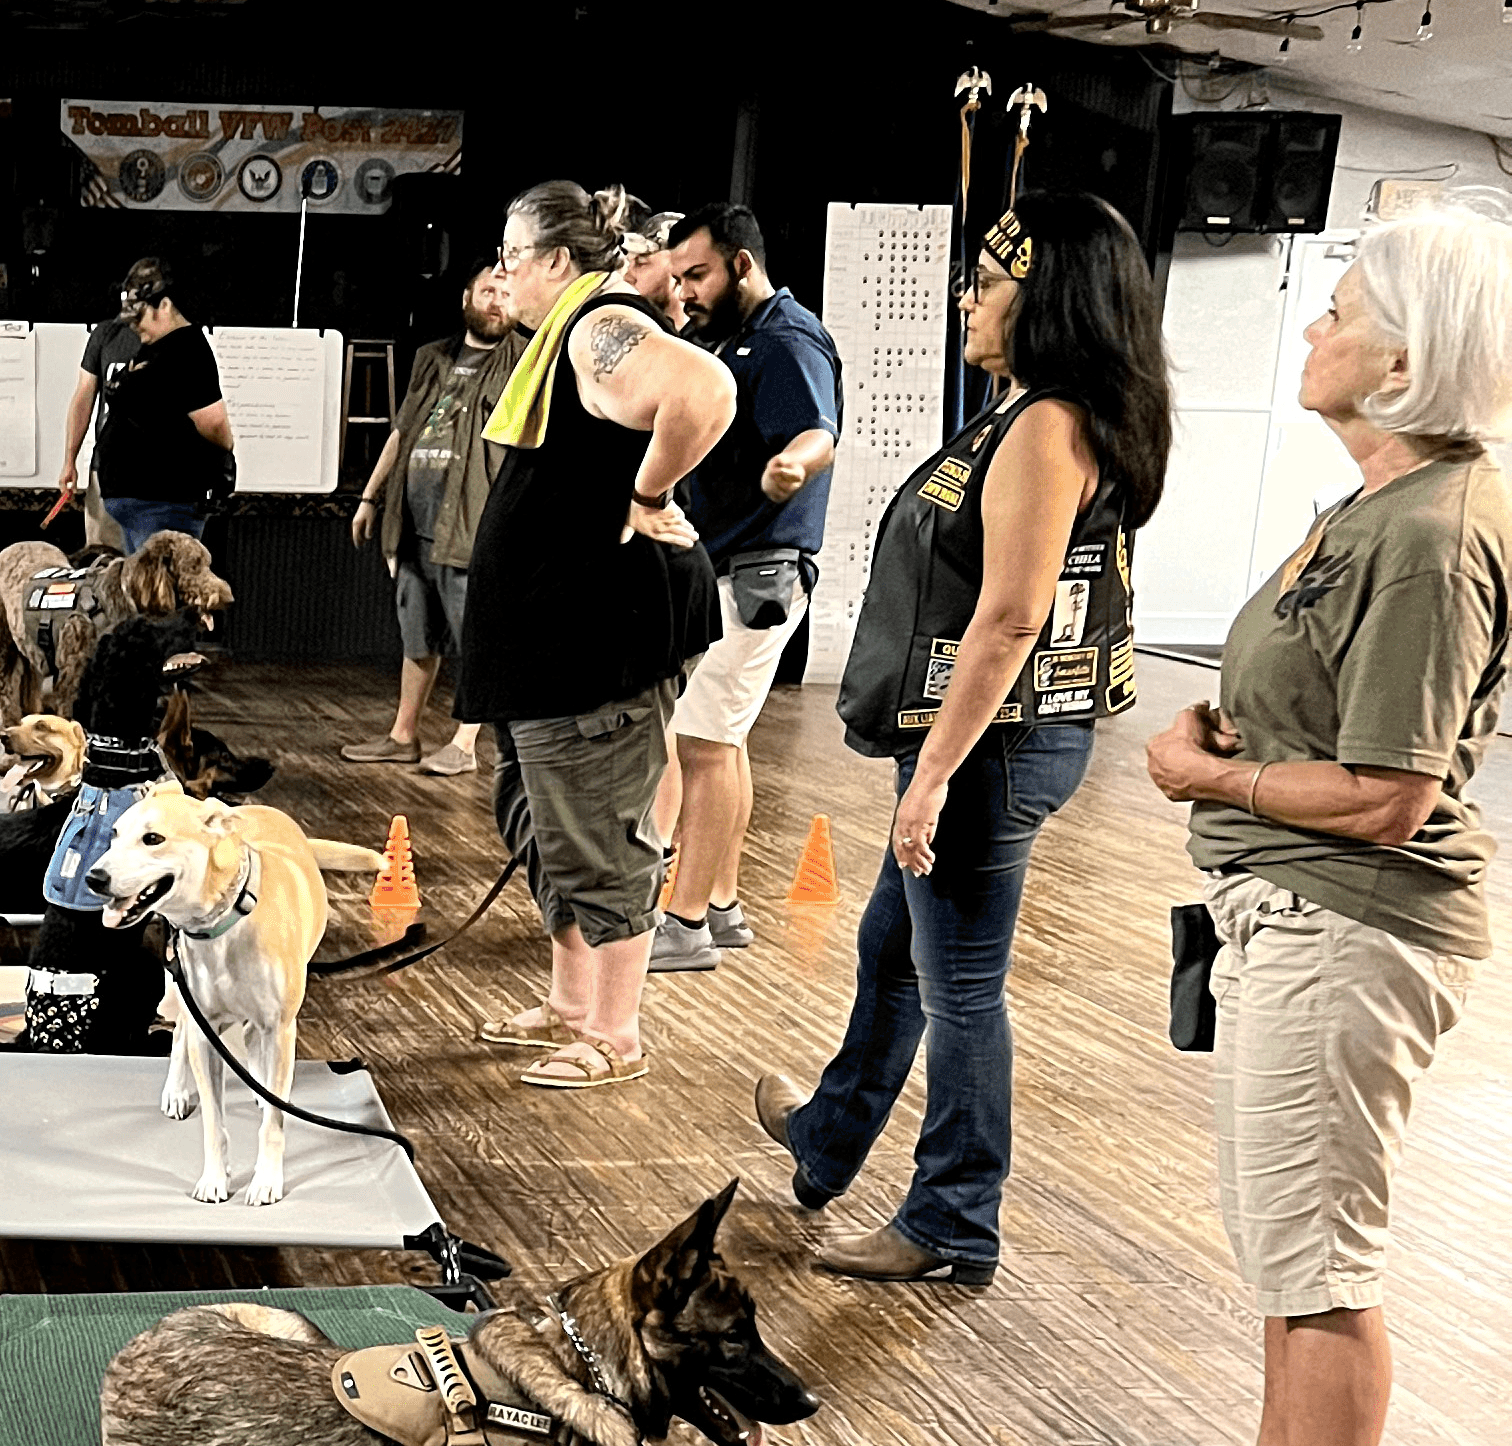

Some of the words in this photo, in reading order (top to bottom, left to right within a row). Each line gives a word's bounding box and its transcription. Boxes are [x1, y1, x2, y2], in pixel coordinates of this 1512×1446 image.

[68, 106, 210, 138] Tomball
[219, 111, 294, 140] VFW
[300, 113, 372, 142] Post
